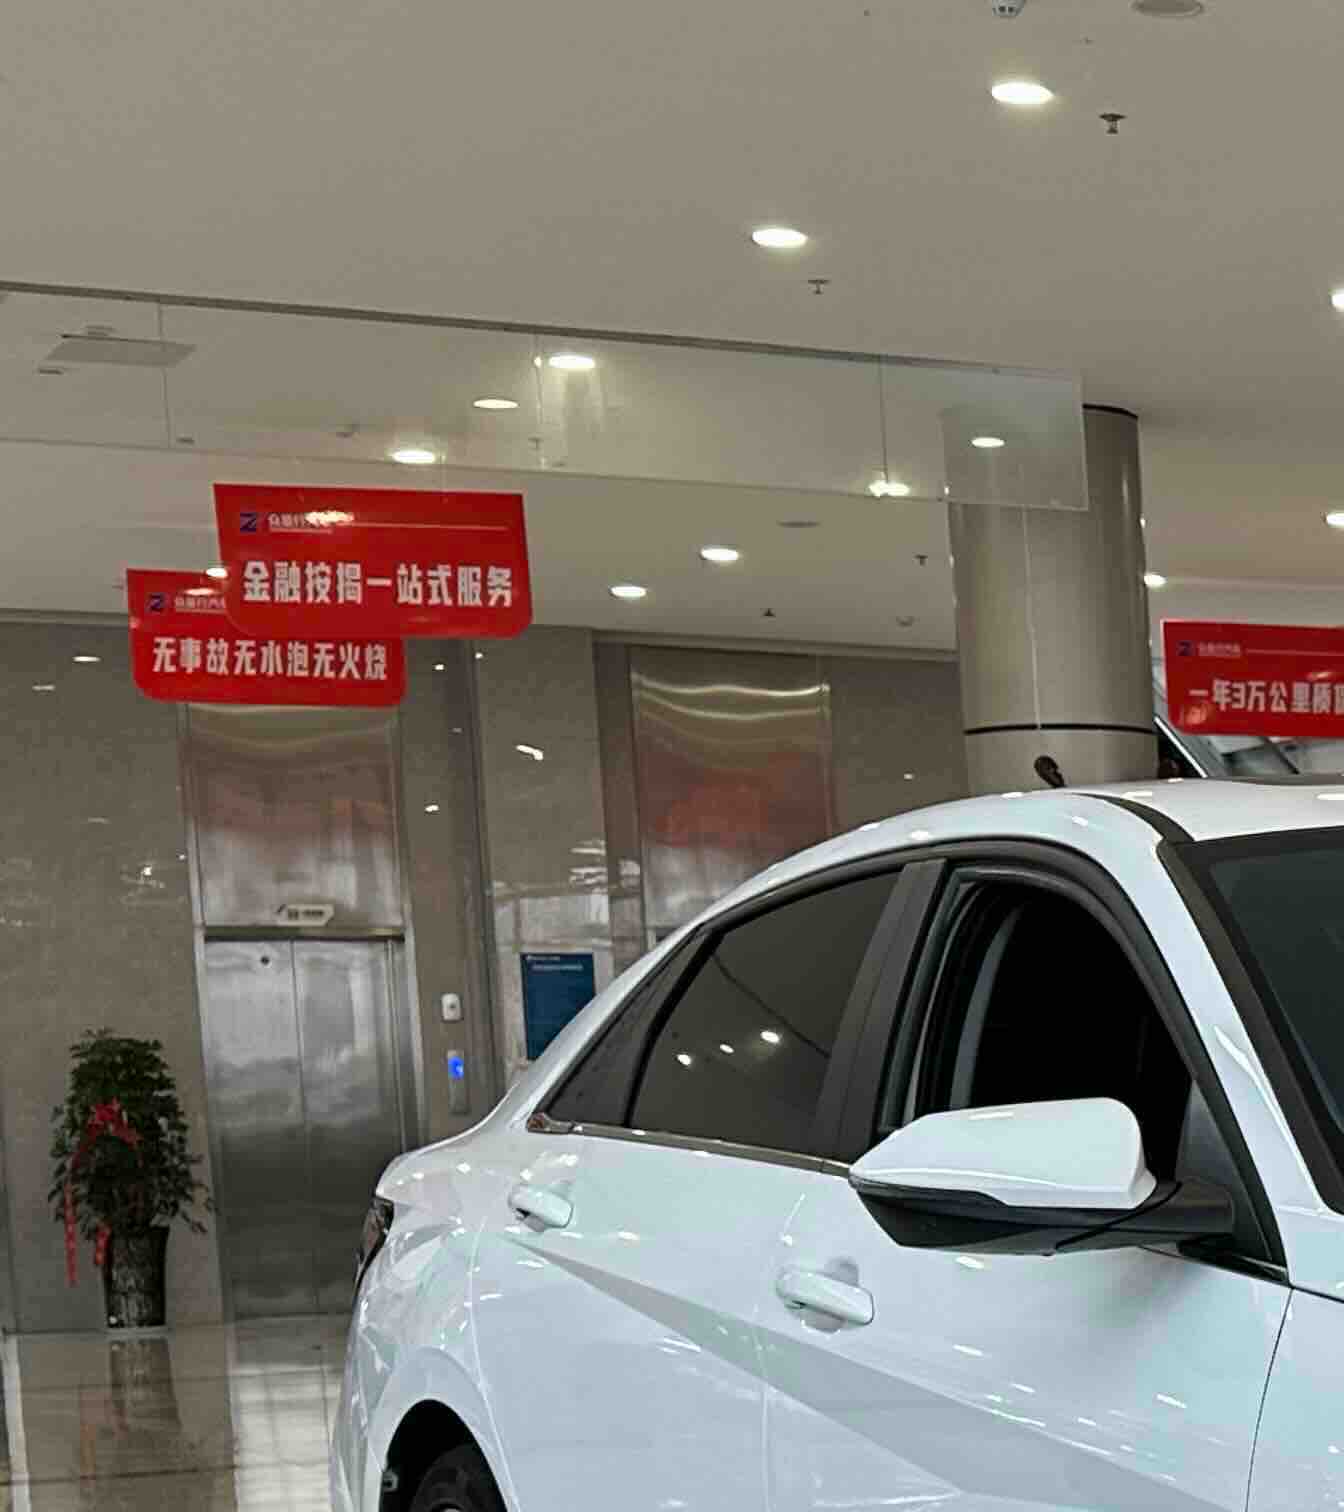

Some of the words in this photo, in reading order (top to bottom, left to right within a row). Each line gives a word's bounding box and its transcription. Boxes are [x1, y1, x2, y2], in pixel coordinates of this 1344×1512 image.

[243, 560, 514, 608] 金融按揭一站式服务
[153, 637, 388, 681] 无事故无水泡无火烧
